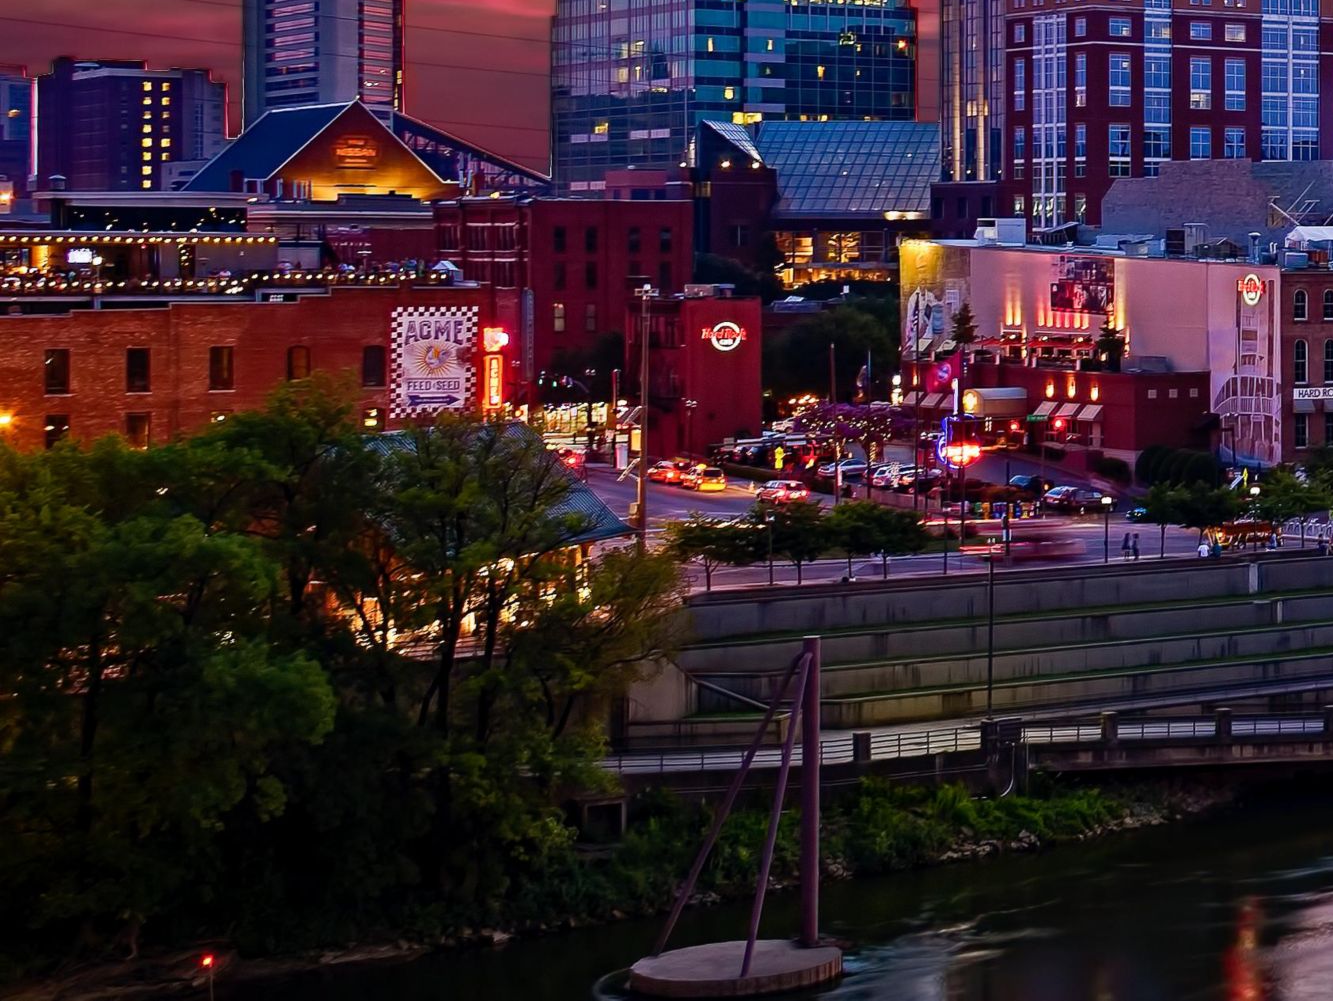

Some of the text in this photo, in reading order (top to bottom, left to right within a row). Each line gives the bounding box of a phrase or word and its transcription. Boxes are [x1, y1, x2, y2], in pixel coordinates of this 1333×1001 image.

[404, 320, 463, 344] ACME
[407, 381, 432, 391] FEED
[436, 380, 460, 390] SEED
[1298, 388, 1321, 398] HARD
